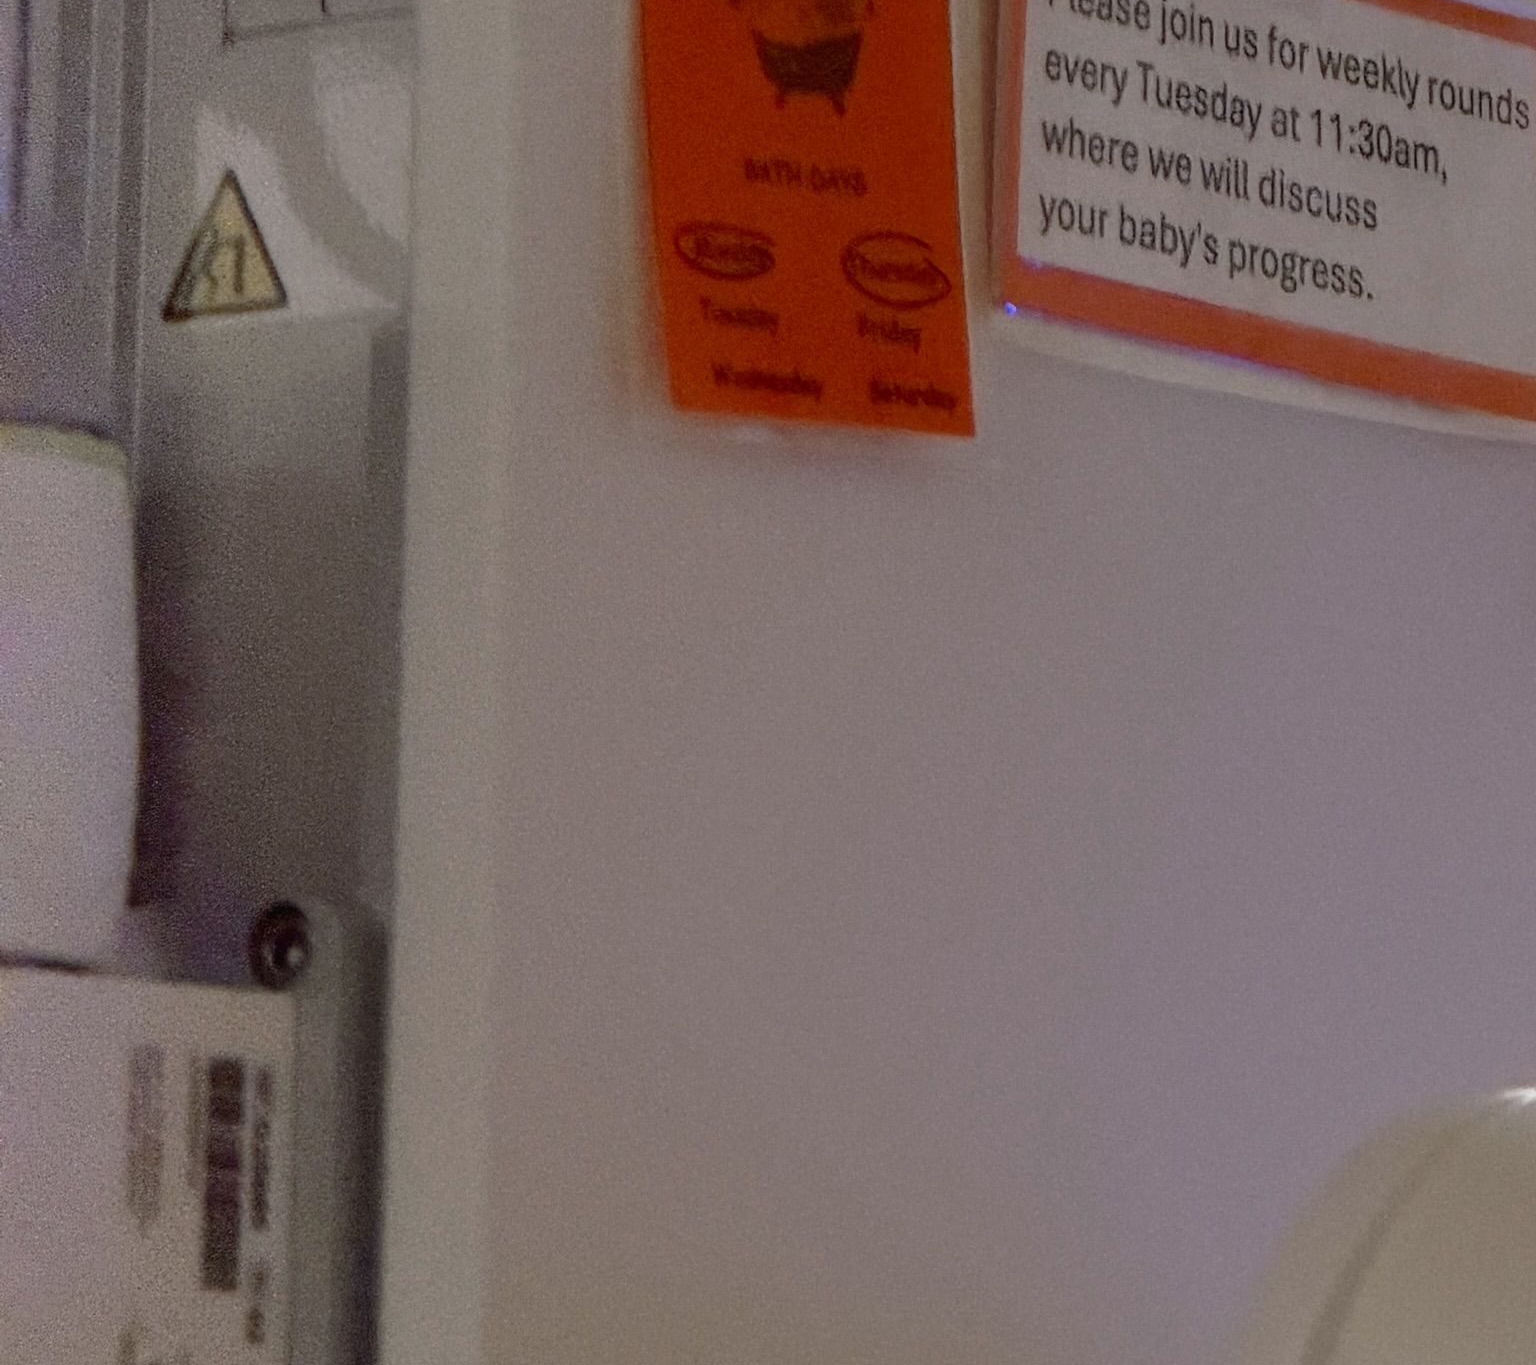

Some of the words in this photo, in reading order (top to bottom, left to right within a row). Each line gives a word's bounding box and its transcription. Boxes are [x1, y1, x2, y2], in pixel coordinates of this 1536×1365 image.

[1044, 51, 1128, 107] every
[1136, 60, 1262, 142] Tuesday
[1271, 106, 1300, 142] at
[1310, 109, 1448, 185] 11:30am,
[1224, 23, 1259, 59] us
[1269, 25, 1309, 74] for
[1316, 47, 1421, 108] weekly
[1428, 77, 1531, 131] rounds
[1041, 118, 1139, 174] where
[1148, 147, 1192, 185] we
[1200, 156, 1251, 202] will
[1258, 169, 1379, 231] discuss
[1038, 192, 1108, 237] your
[1119, 204, 1219, 269] baby's
[1228, 239, 1375, 301] progress.
